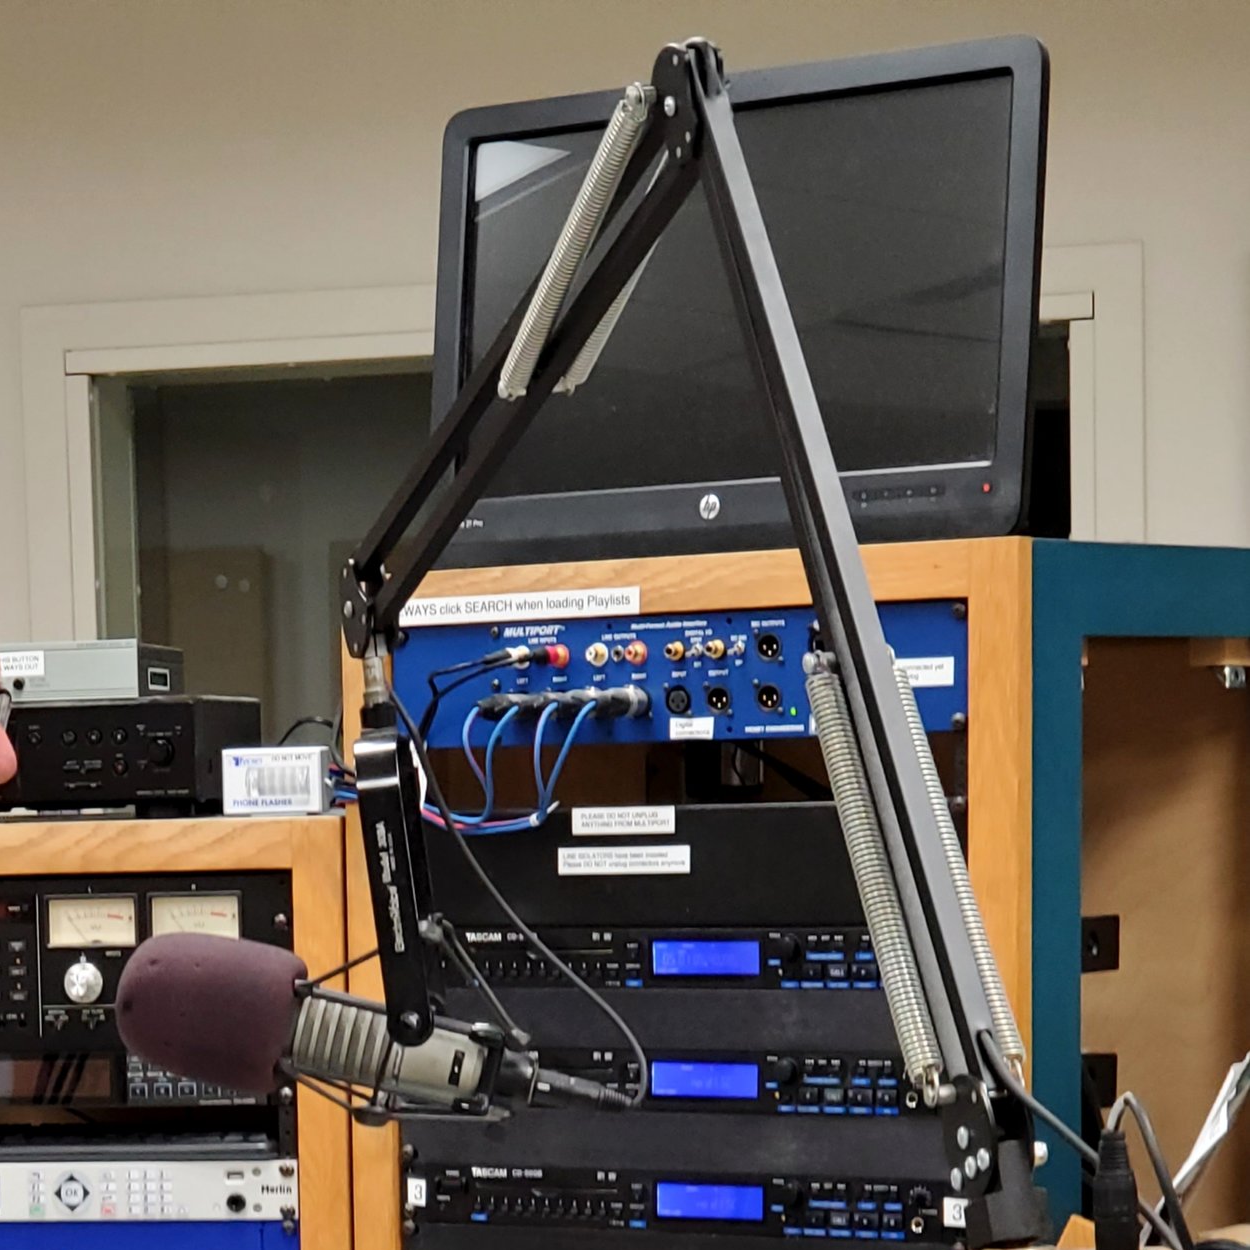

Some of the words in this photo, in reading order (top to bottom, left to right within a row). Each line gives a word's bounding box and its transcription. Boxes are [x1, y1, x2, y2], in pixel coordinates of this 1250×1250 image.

[440, 600, 462, 615] click
[465, 600, 513, 614] SEARCH
[516, 598, 544, 612] when
[546, 596, 584, 612] loading
[587, 593, 631, 609] Playlists
[503, 625, 561, 638] MULTIPORT
[232, 798, 259, 806] PHONE
[261, 798, 293, 806] FLASHER
[466, 932, 502, 942] TASCAM
[472, 1167, 507, 1178] TASCAM
[65, 1188, 80, 1198] OK
[260, 1184, 293, 1195] Merlin
[414, 1184, 423, 1200] 3
[952, 1205, 962, 1221] 3
